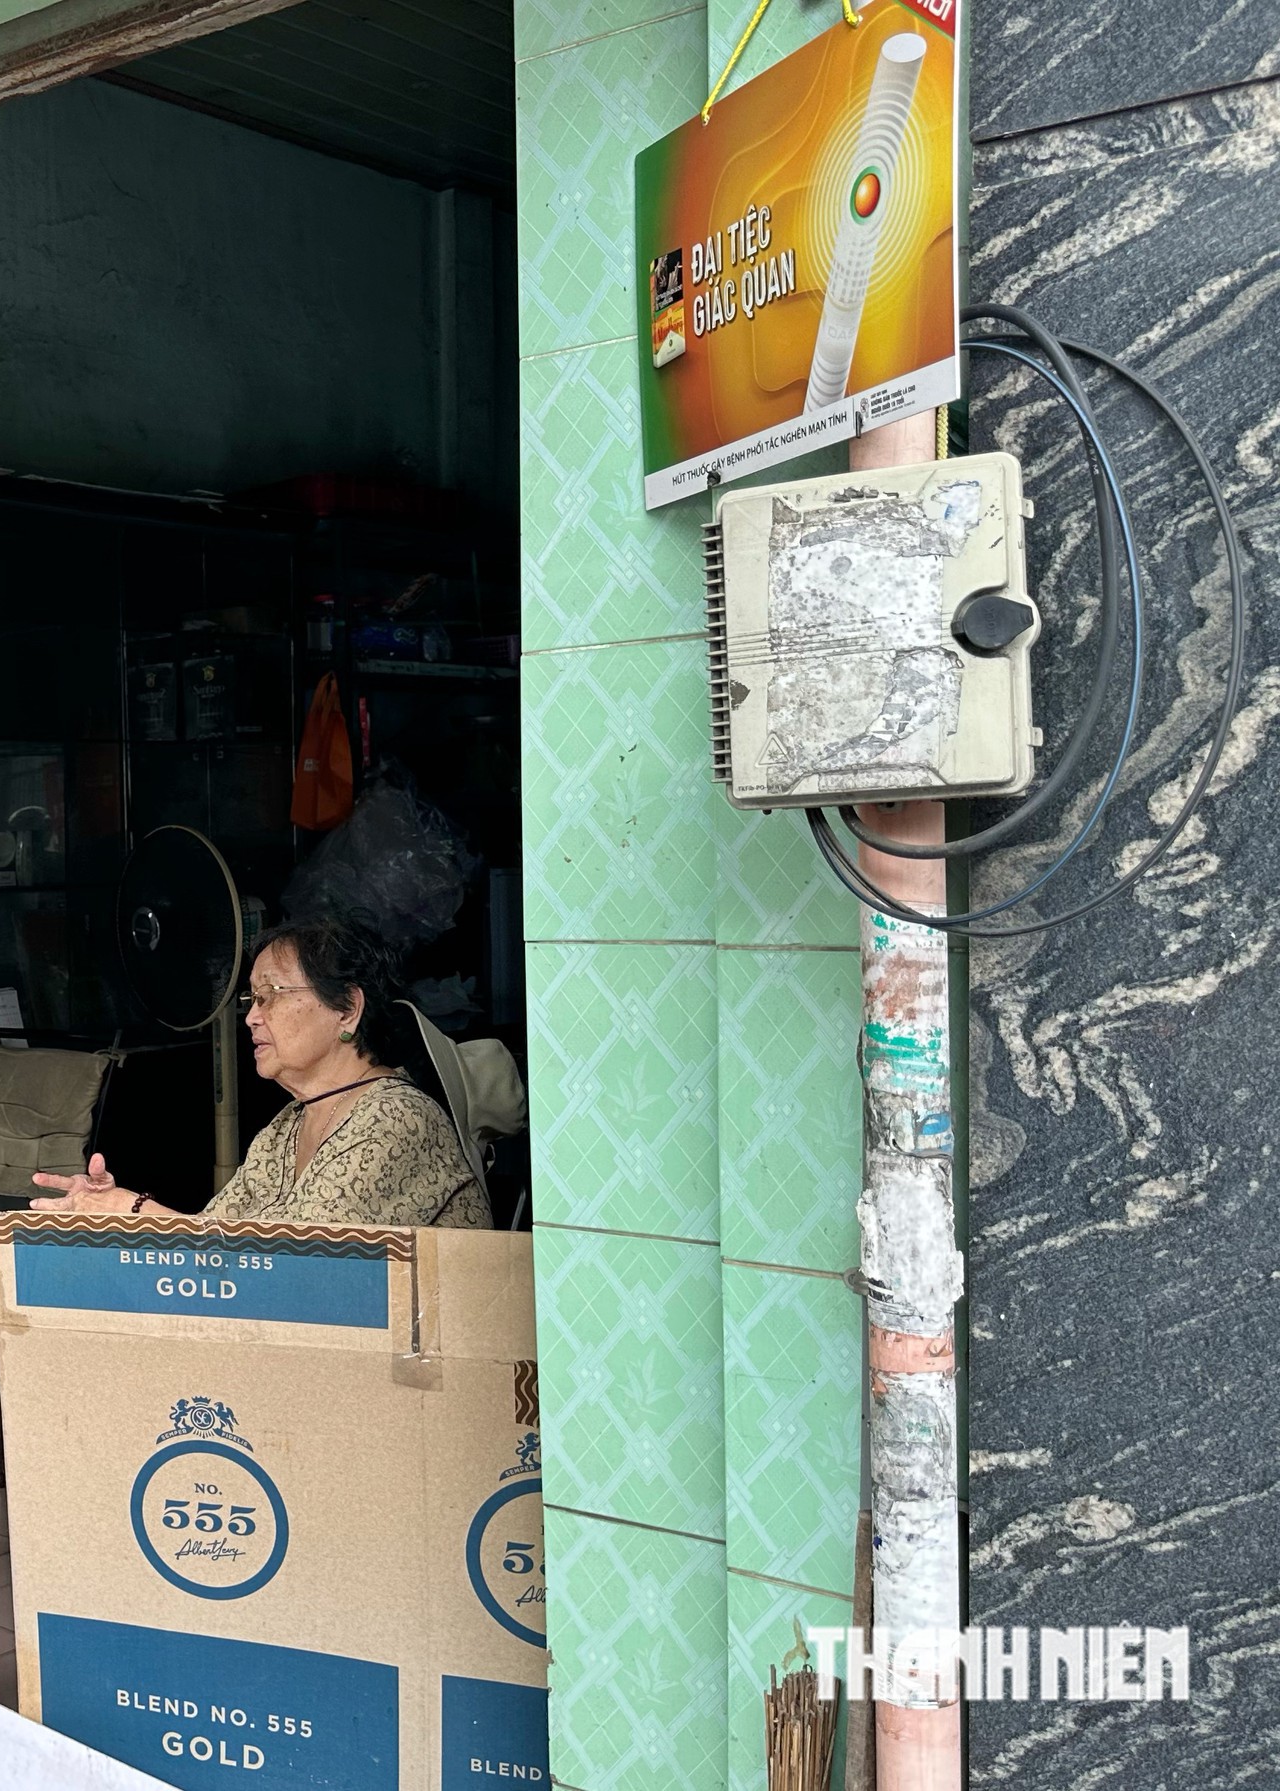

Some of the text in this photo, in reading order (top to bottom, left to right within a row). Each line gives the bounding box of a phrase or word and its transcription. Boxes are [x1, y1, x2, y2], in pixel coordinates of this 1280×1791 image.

[691, 204, 771, 285] ĐẠI TIỆC
[693, 277, 736, 337] GIÁC
[741, 248, 796, 319] QUAN
[672, 411, 847, 486] HÚT THUỐC GÂY BỆNH PHỔI TẮC NGHẼN MẠN TÍNH
[120, 1250, 274, 1271] BLEND NO. 555
[156, 1277, 238, 1300] GOLD
[160, 1428, 188, 1440] SEMPER
[504, 1464, 535, 1478] SEMPER
[194, 1483, 223, 1495] NO.
[162, 1499, 256, 1537] 555
[503, 1541, 546, 1575] 5
[116, 1689, 313, 1739] BLEND NO. 555
[162, 1731, 265, 1771] GOLD
[470, 1758, 542, 1782] BLEND
